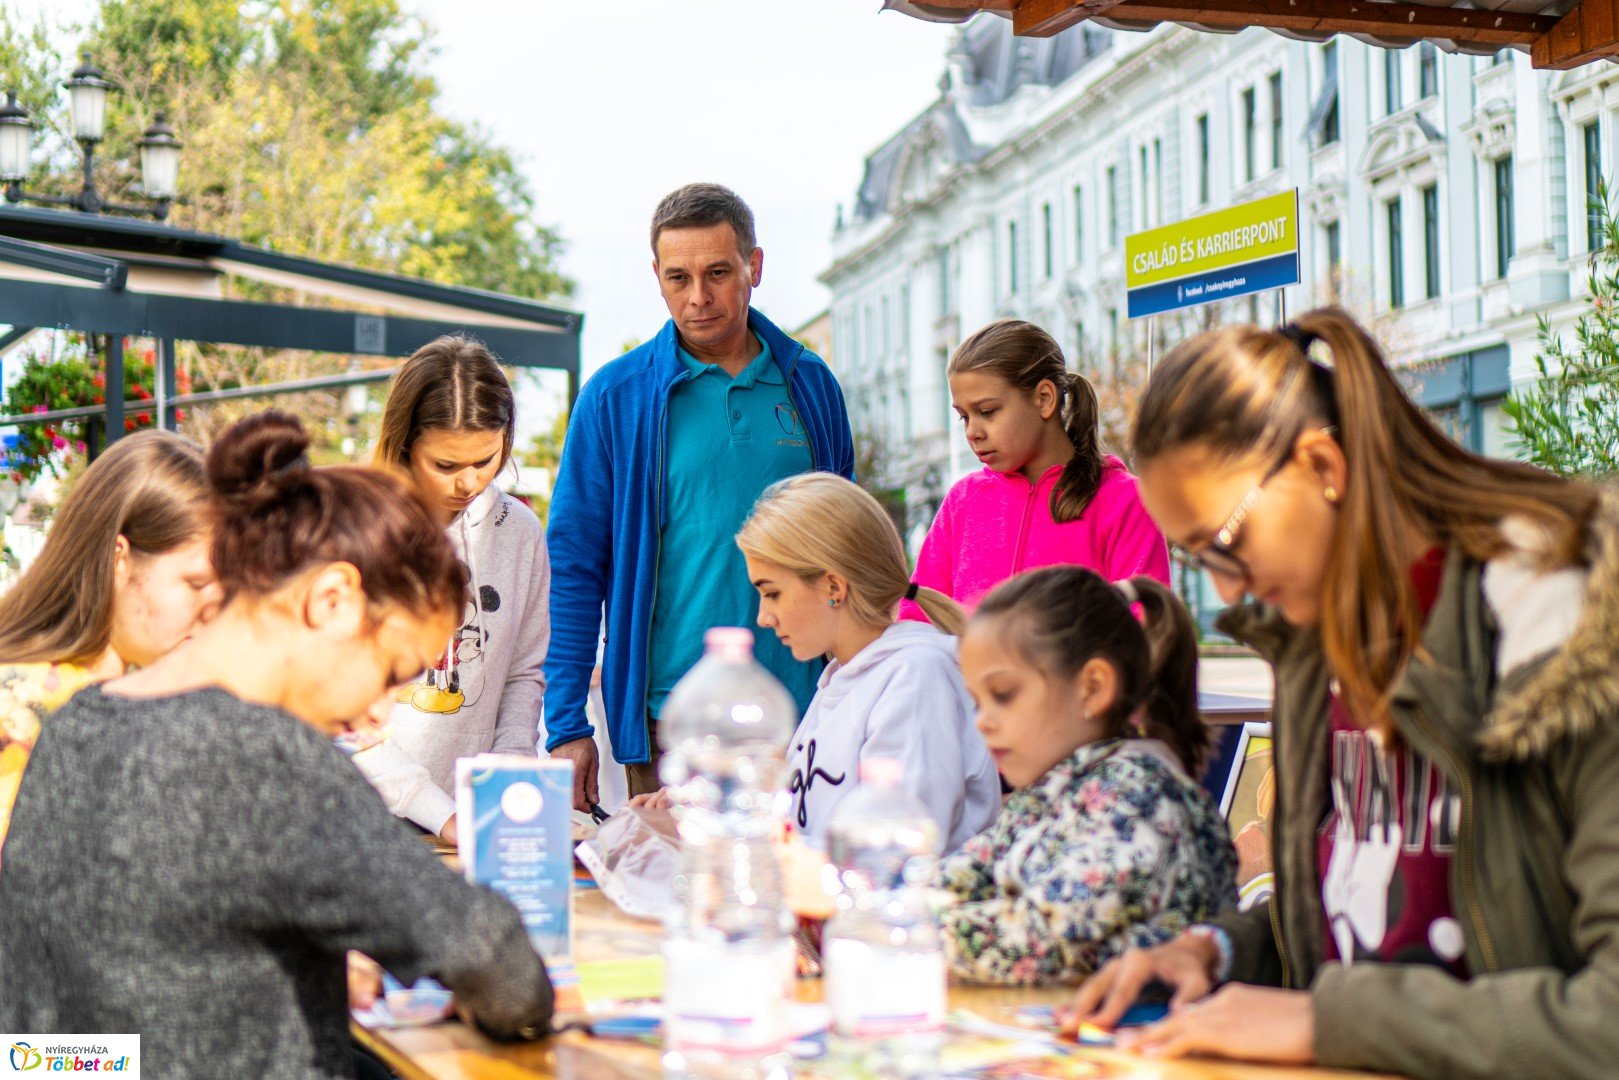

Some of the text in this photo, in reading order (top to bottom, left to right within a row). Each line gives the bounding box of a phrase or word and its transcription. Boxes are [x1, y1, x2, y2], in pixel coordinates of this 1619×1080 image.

[1133, 216, 1287, 274] CSALÁD ÉS KARRIERPONT
